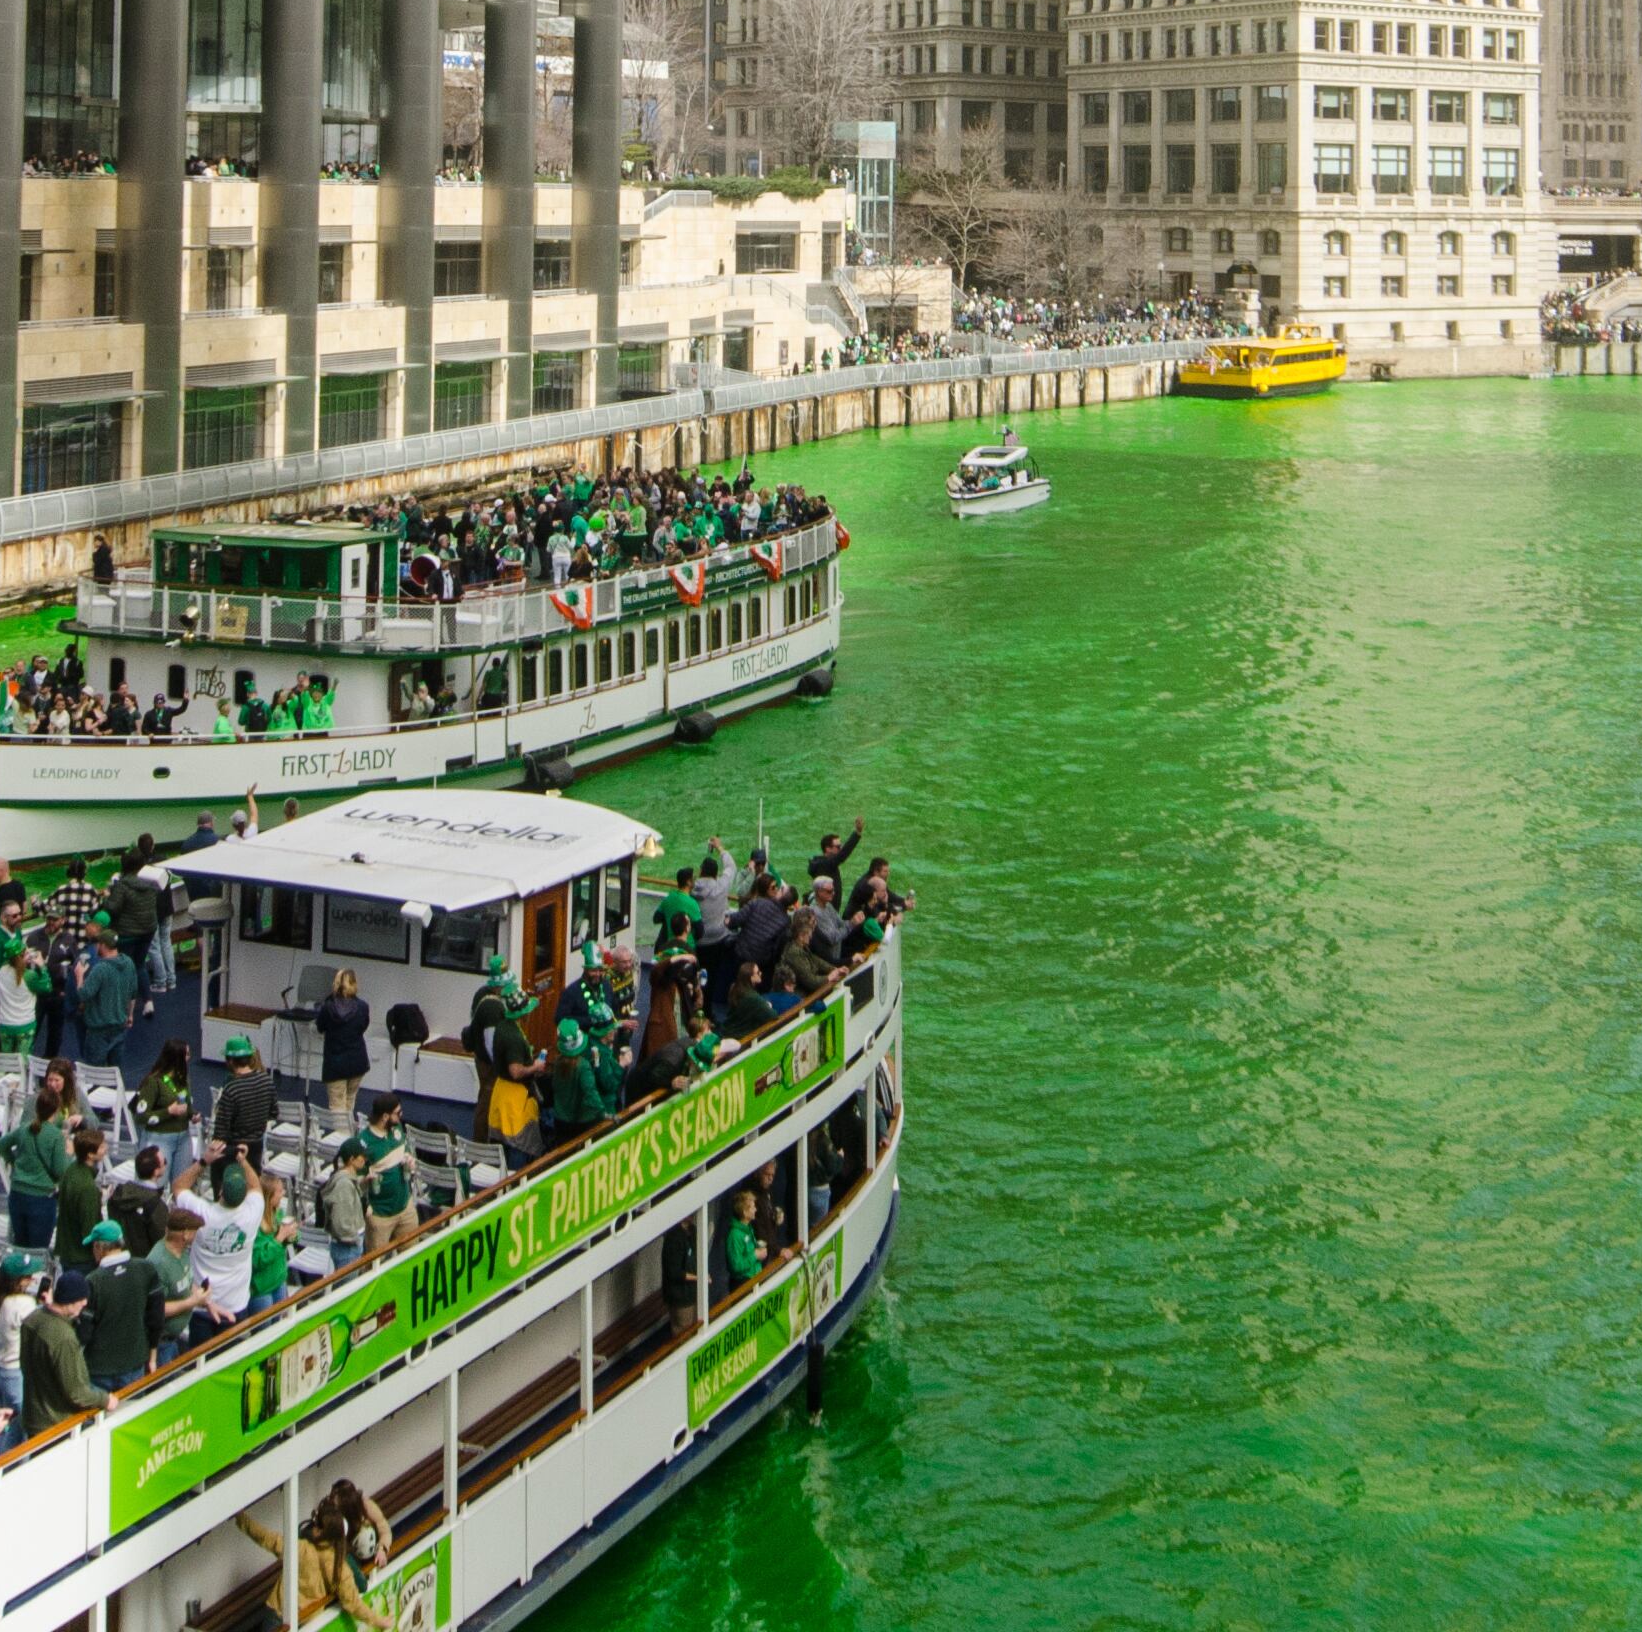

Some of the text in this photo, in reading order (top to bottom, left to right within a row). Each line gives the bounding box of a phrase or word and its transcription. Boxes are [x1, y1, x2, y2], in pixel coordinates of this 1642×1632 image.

[732, 643, 790, 682] FIRST LADY
[33, 767, 121, 780] LEADING LADY
[281, 748, 397, 777] FIRST LADY
[344, 808, 565, 843] wendella
[331, 906, 399, 927] wendella
[411, 1069, 746, 1329] HAPPY ST. PATRICK'S SEASON
[692, 1288, 785, 1383] EVERY GOOD HOLIDAY
[693, 1339, 757, 1413] HAS A SEASON
[150, 1413, 193, 1449] MUST BE A
[136, 1430, 204, 1489] JAMESON
